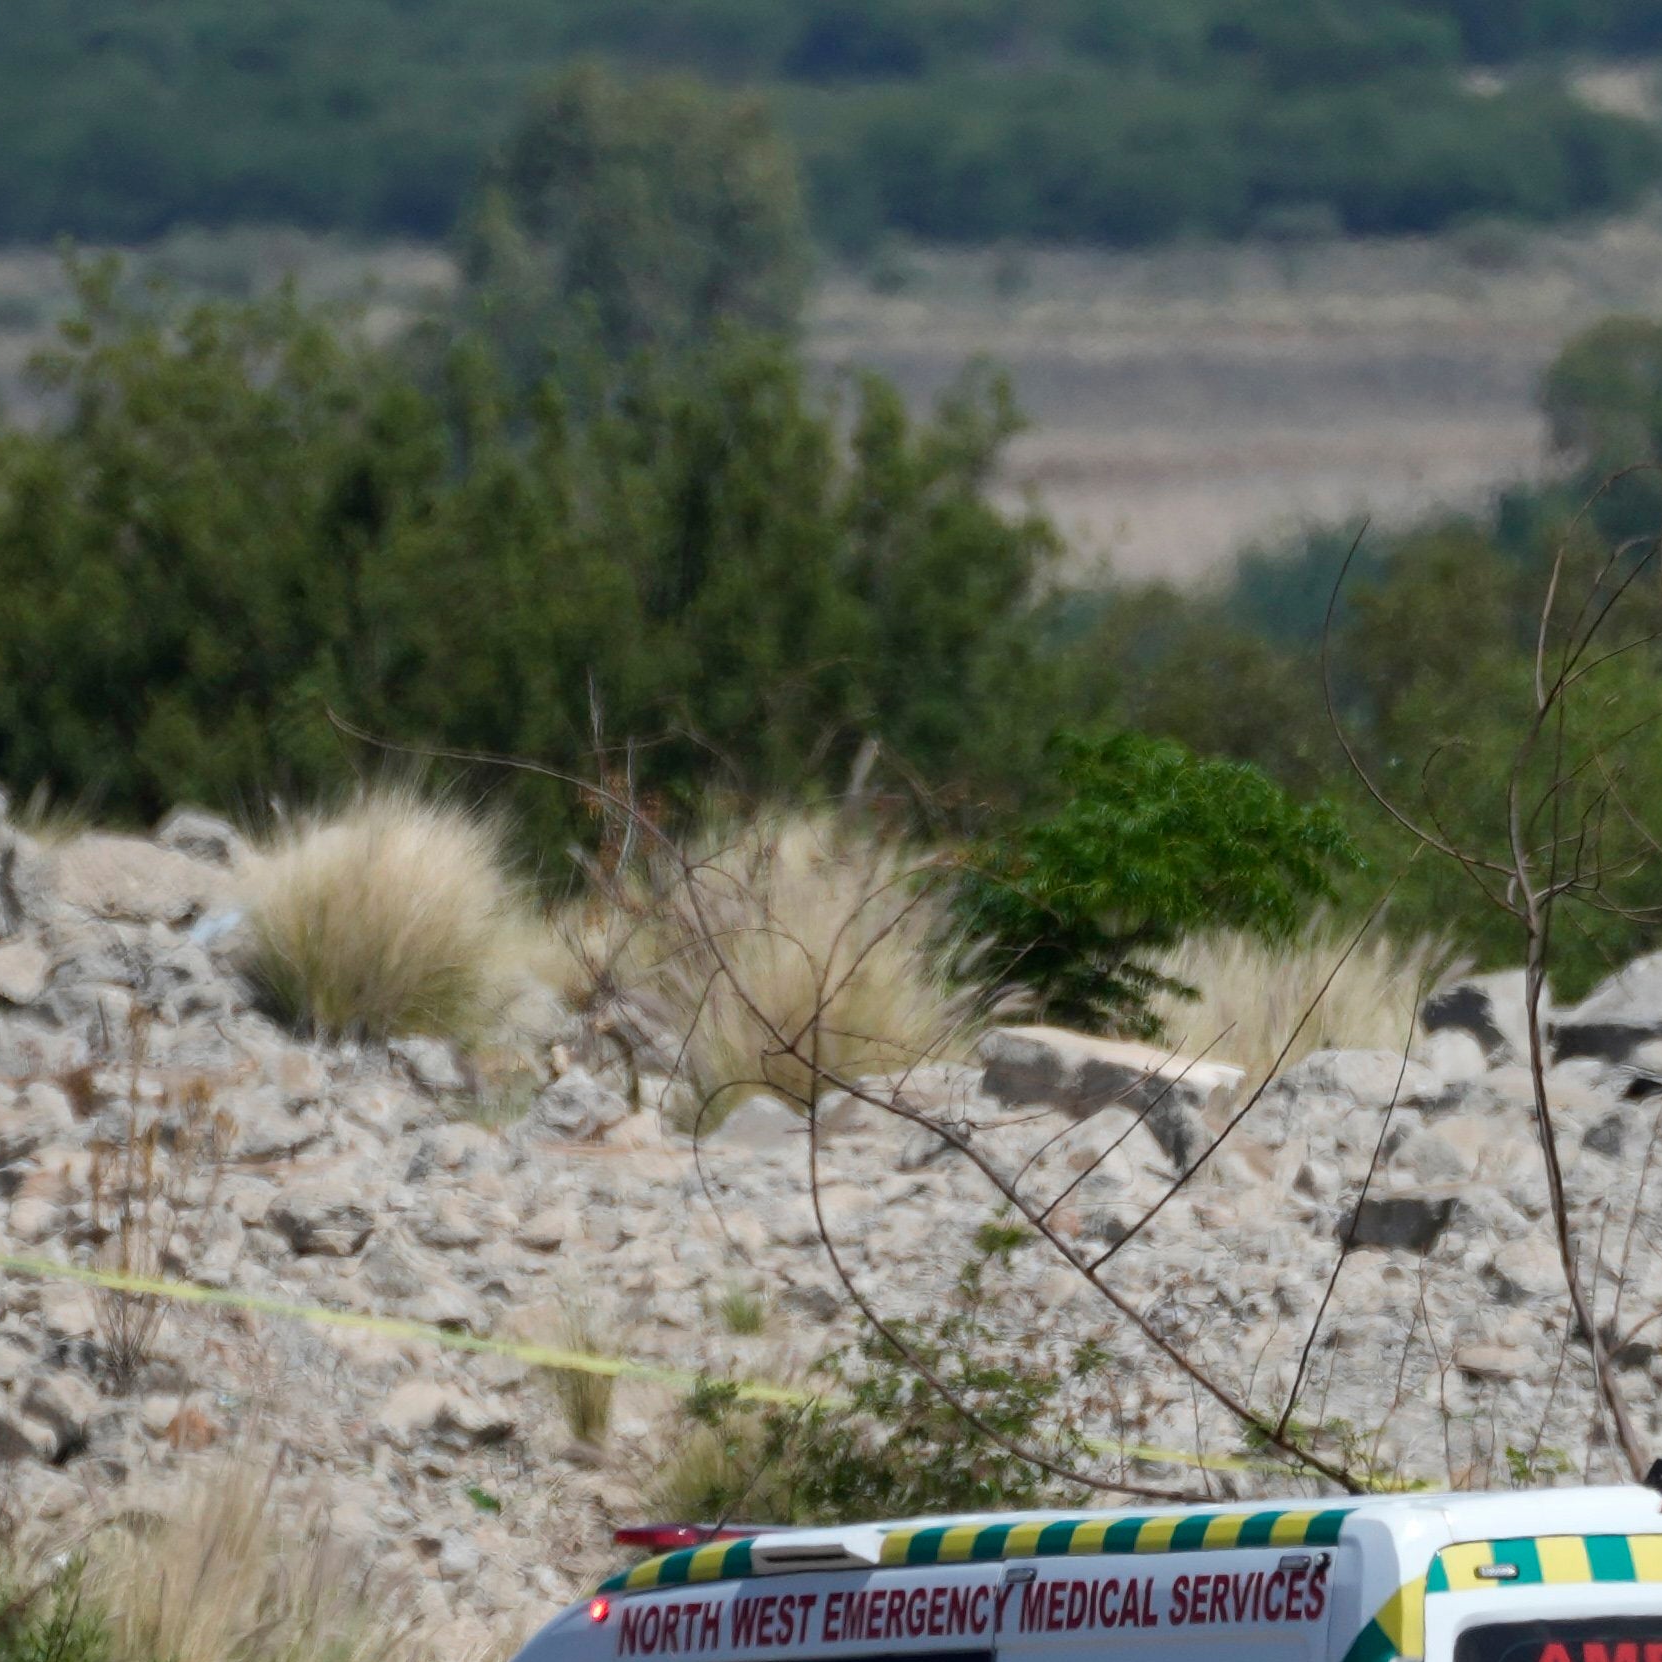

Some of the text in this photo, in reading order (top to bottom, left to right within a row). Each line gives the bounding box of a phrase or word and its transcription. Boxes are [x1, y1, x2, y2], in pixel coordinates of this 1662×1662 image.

[617, 1564, 1327, 1657] NORTH WEST EMERGENCY MEDICAL SERVICES
